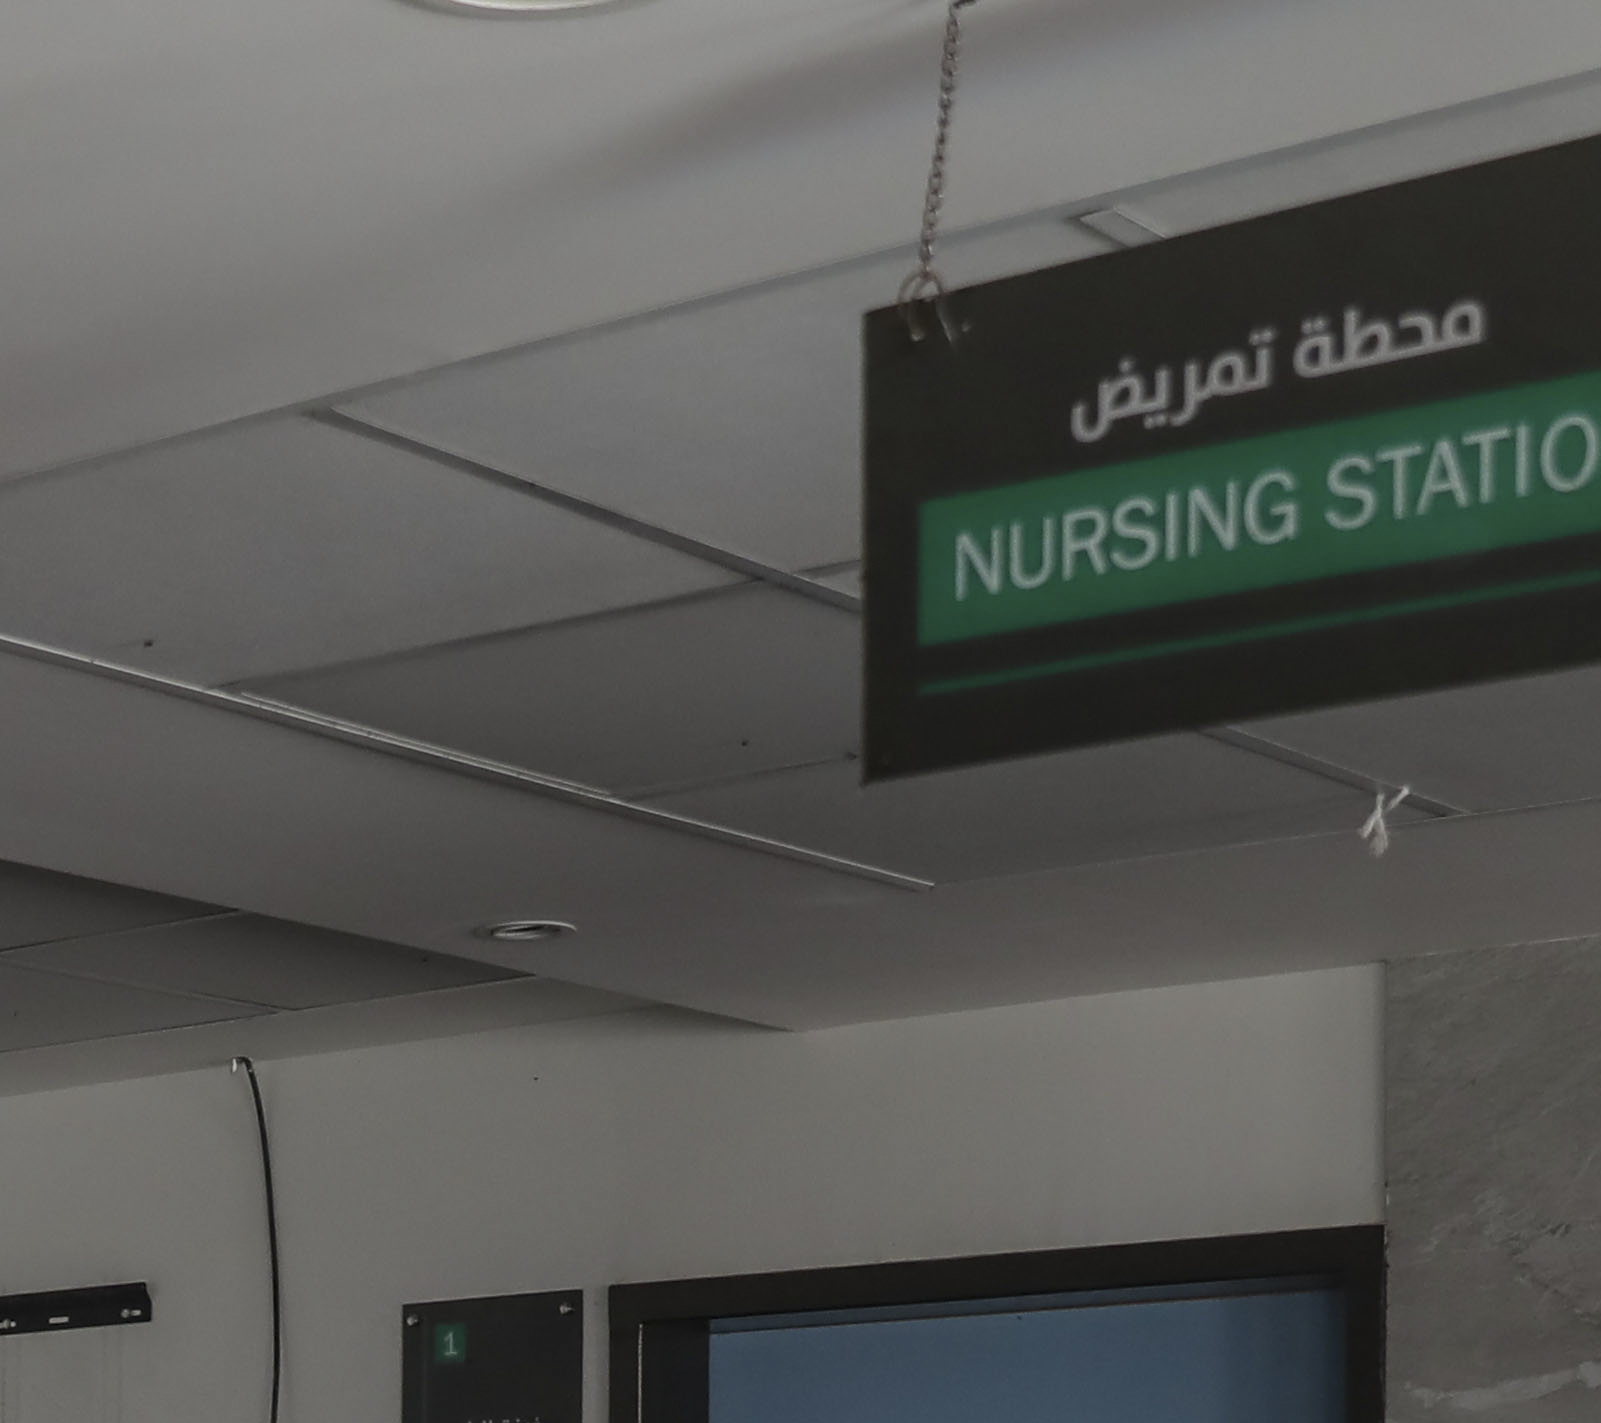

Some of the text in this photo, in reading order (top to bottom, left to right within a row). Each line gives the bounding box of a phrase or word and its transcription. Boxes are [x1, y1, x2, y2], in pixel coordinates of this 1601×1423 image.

[1070, 297, 1485, 445] محطة تمريض
[954, 467, 1300, 603] NURSING
[443, 1330, 459, 1357] 1
